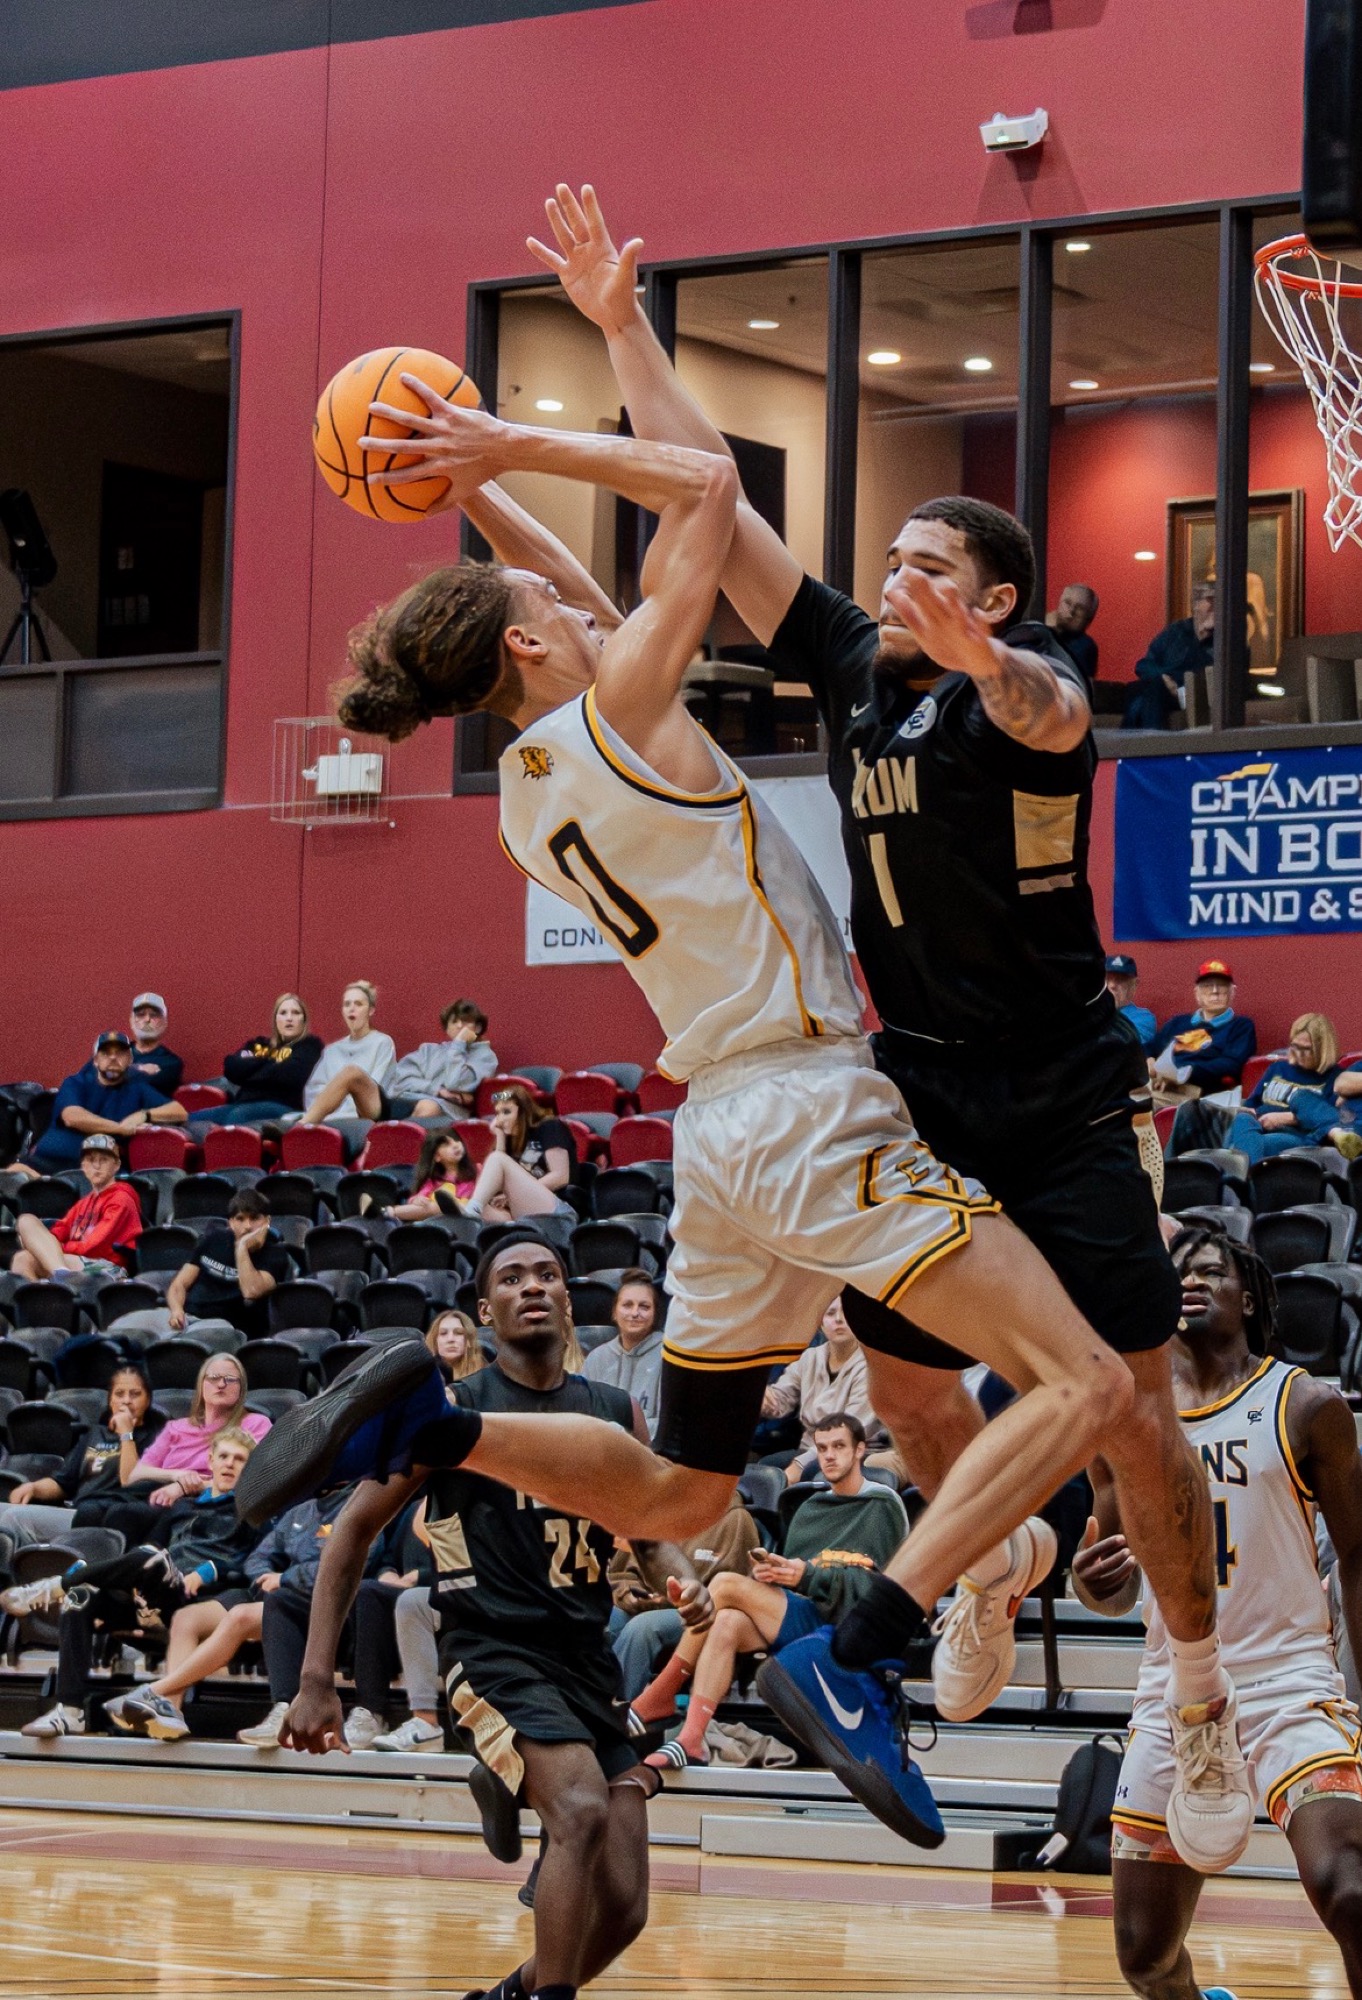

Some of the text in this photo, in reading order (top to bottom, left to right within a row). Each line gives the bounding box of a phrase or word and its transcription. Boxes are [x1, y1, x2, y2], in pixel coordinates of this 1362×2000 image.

[1190, 774, 1362, 815] CHAMP
[1190, 827, 1258, 877] IN
[547, 817, 662, 960] 0
[1189, 890, 1301, 926] MIND
[1309, 888, 1342, 922] &
[544, 1518, 601, 1588] 24
